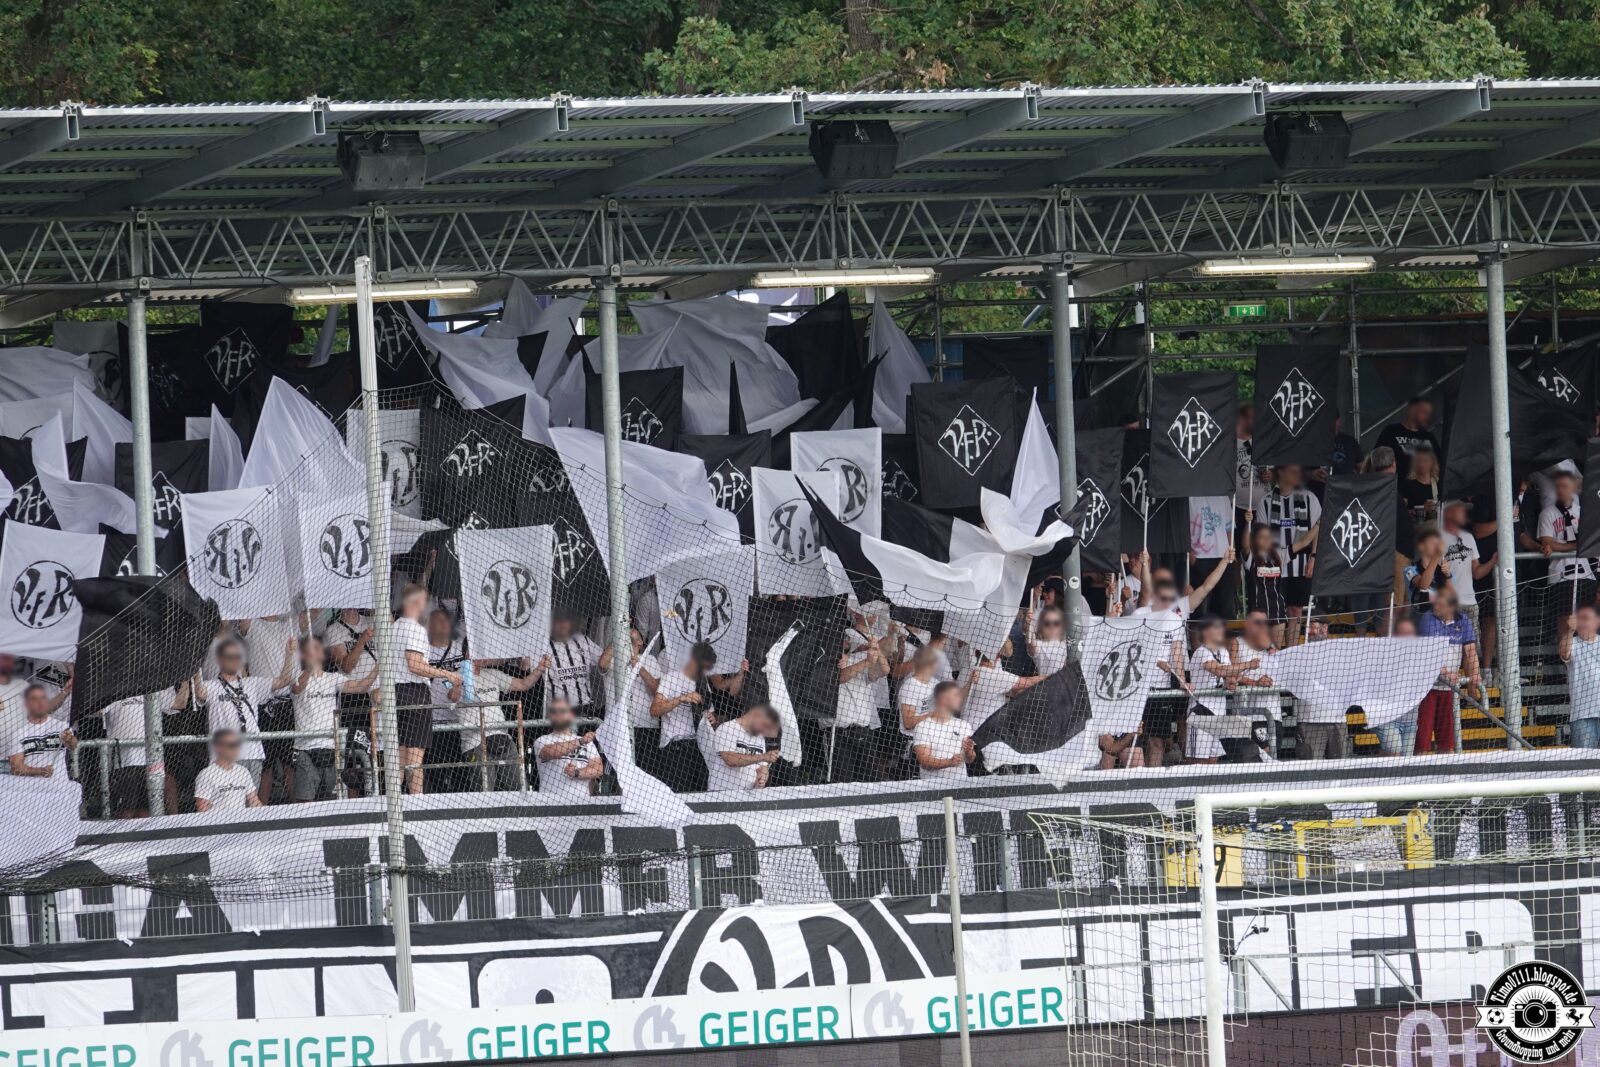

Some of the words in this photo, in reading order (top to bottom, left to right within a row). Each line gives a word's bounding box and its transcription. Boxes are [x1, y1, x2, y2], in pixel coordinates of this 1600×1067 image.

[323, 824, 766, 927] IMMER
[699, 1005, 840, 1048] GEIGER
[927, 986, 1065, 1033] GEIGER
[0, 1044, 138, 1067] EIGER
[228, 1035, 375, 1067] GEIGER
[467, 1020, 611, 1061] GEIGER
